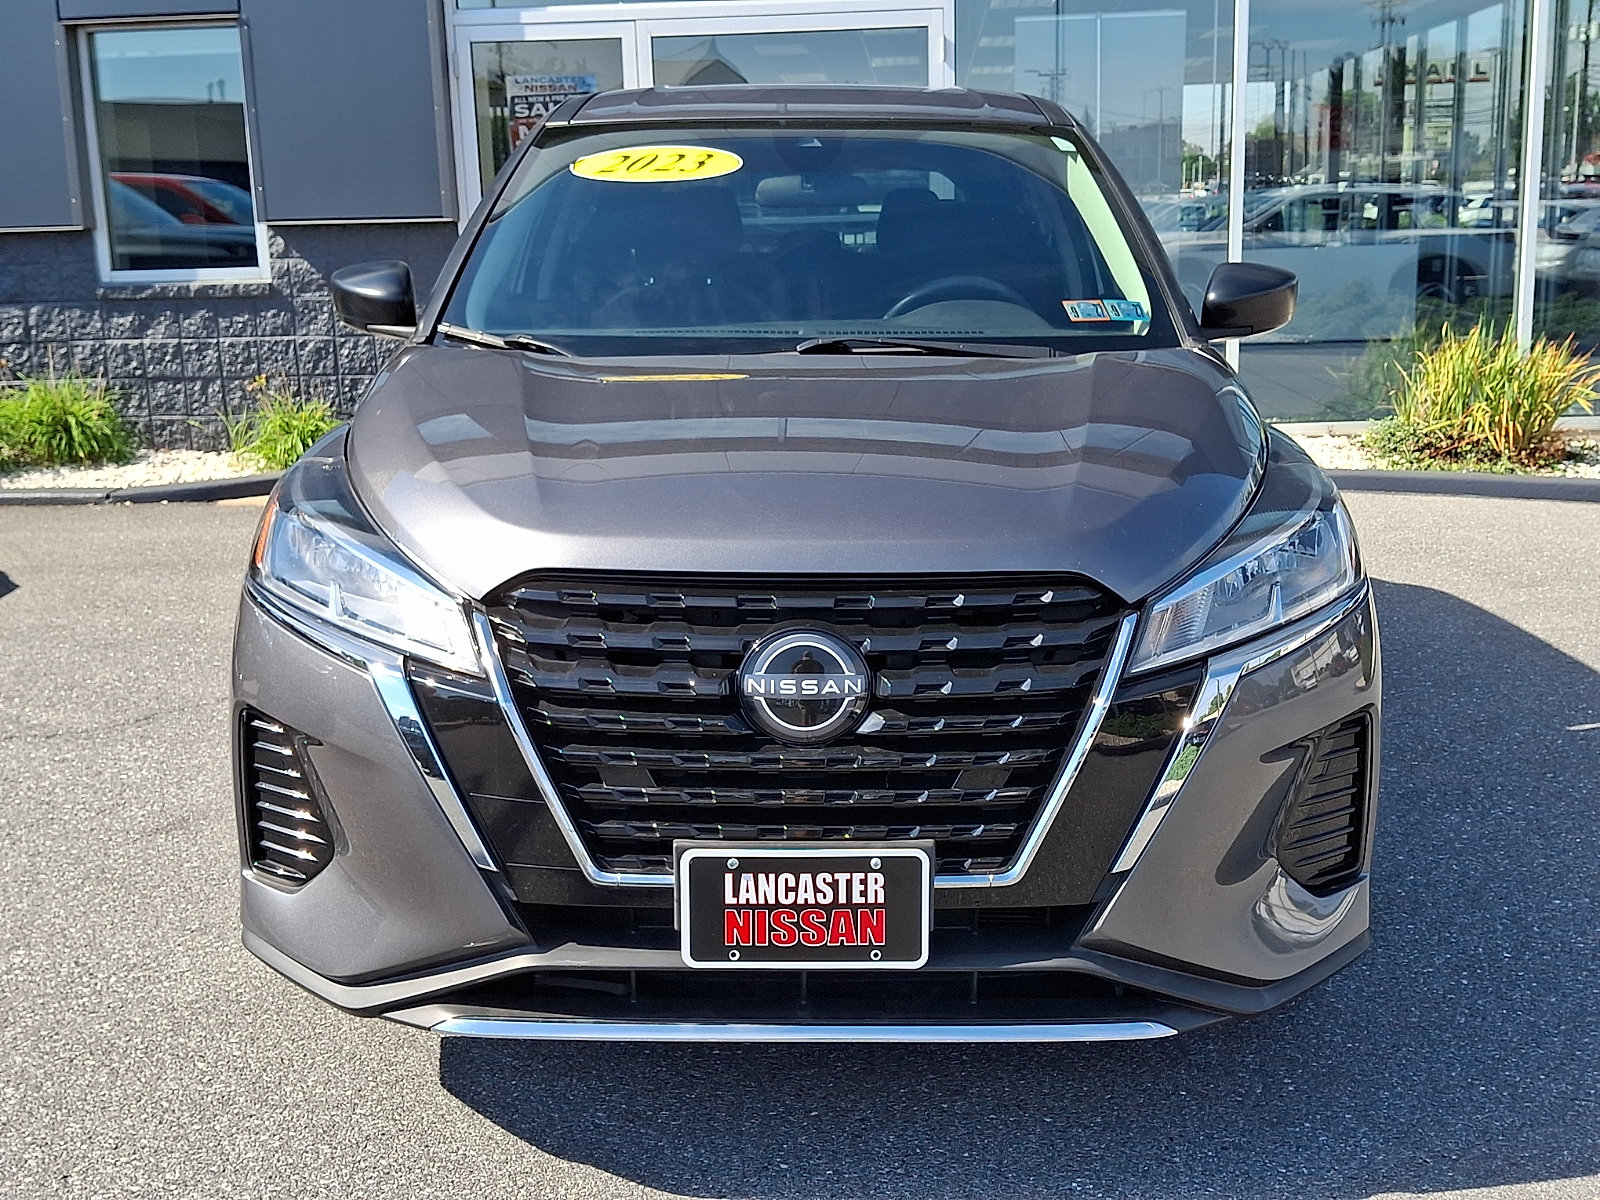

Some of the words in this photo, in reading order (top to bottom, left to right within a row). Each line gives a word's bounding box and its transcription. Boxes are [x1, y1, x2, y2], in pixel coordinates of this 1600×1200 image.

[525, 84, 578, 92] NISSAN
[597, 153, 714, 174] 2023
[747, 678, 862, 695] NISSAN
[723, 872, 886, 905] LANCASTER
[723, 909, 886, 947] NISSAN
